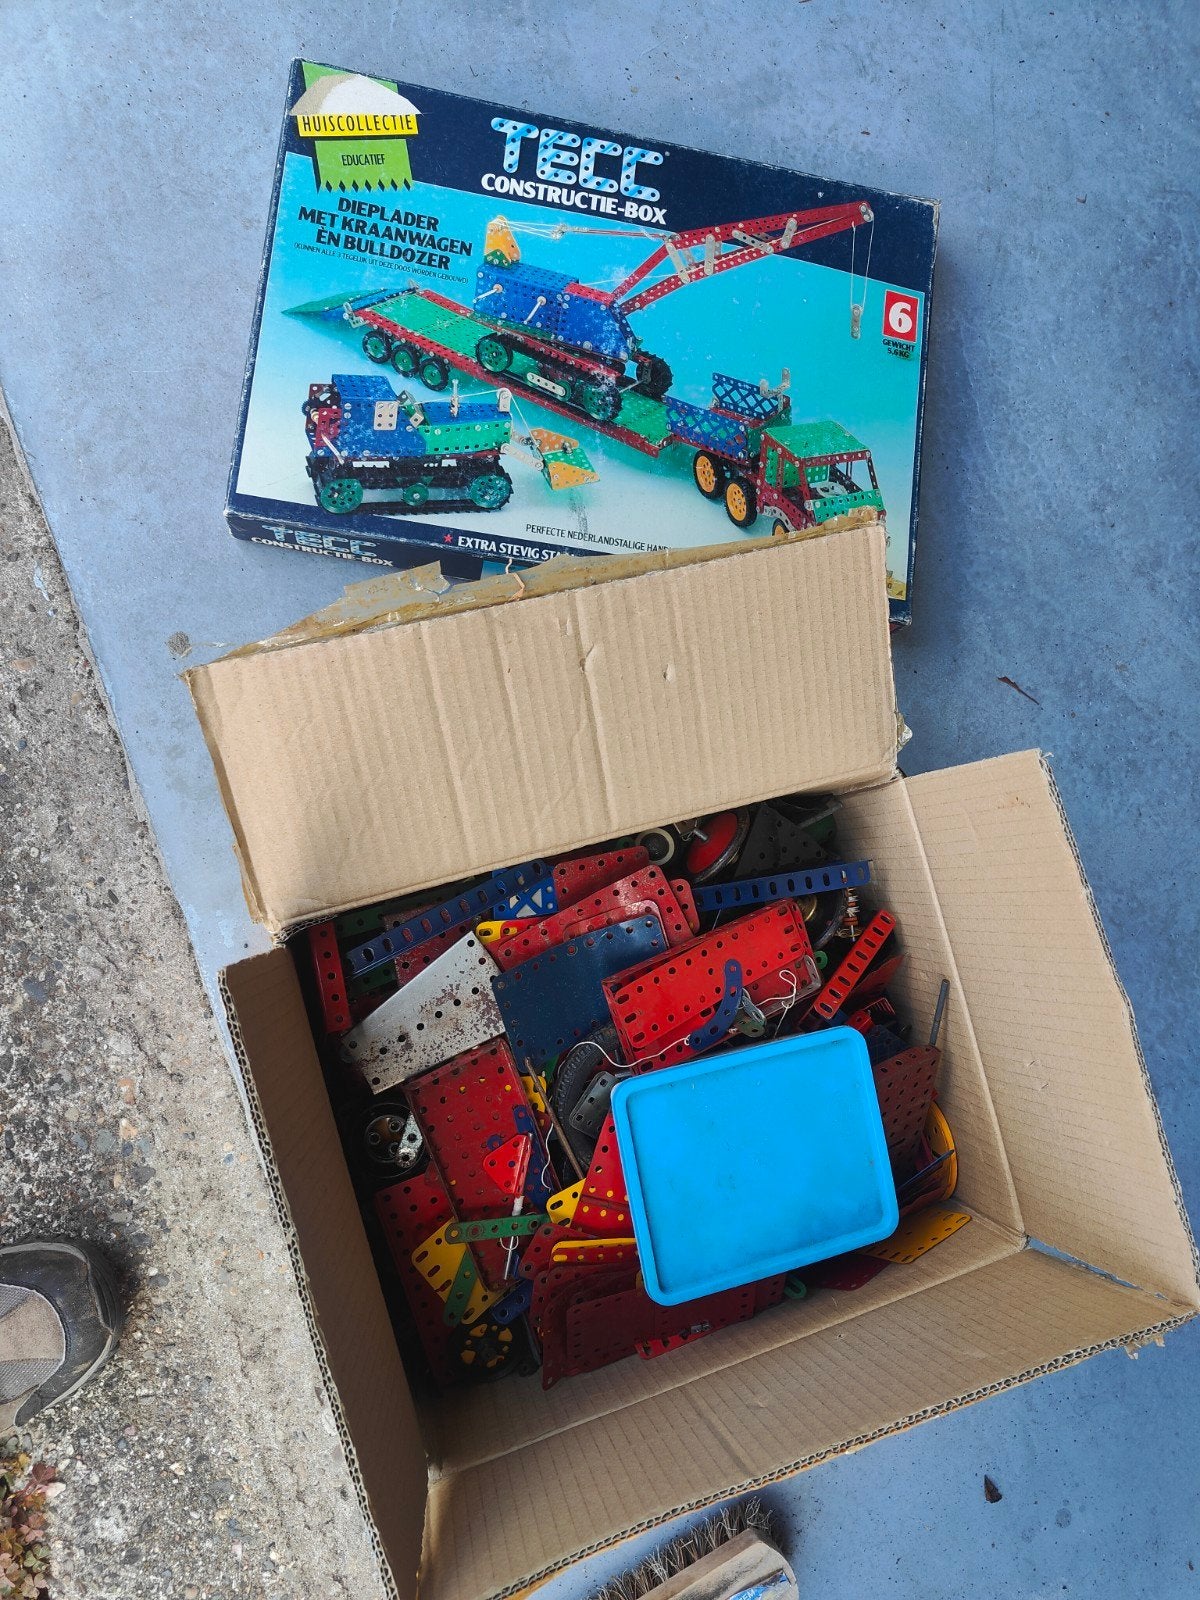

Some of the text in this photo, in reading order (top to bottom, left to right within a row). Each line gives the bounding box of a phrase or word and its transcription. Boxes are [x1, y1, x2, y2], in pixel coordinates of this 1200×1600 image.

[302, 114, 413, 132] HUISCOLLECTIE
[341, 153, 386, 166] EDUCATIEF
[490, 117, 664, 202] TECC
[337, 197, 440, 231] DIEPLADER
[481, 173, 667, 225] CONSTRUCTIE-BOX
[298, 206, 473, 256] MET KRAANWAGEN
[343, 236, 451, 270] BULLDOZER
[888, 301, 913, 334] 6
[882, 339, 915, 352] GEWICHT
[250, 536, 393, 567] CONSTRUCTIE-BOX
[262, 524, 377, 557] TECC
[457, 535, 497, 552] EXTRA
[499, 542, 540, 559] STEVIG
[525, 523, 566, 539] PERFECTE
[567, 531, 646, 551] NEDERLANDSTALIGE
